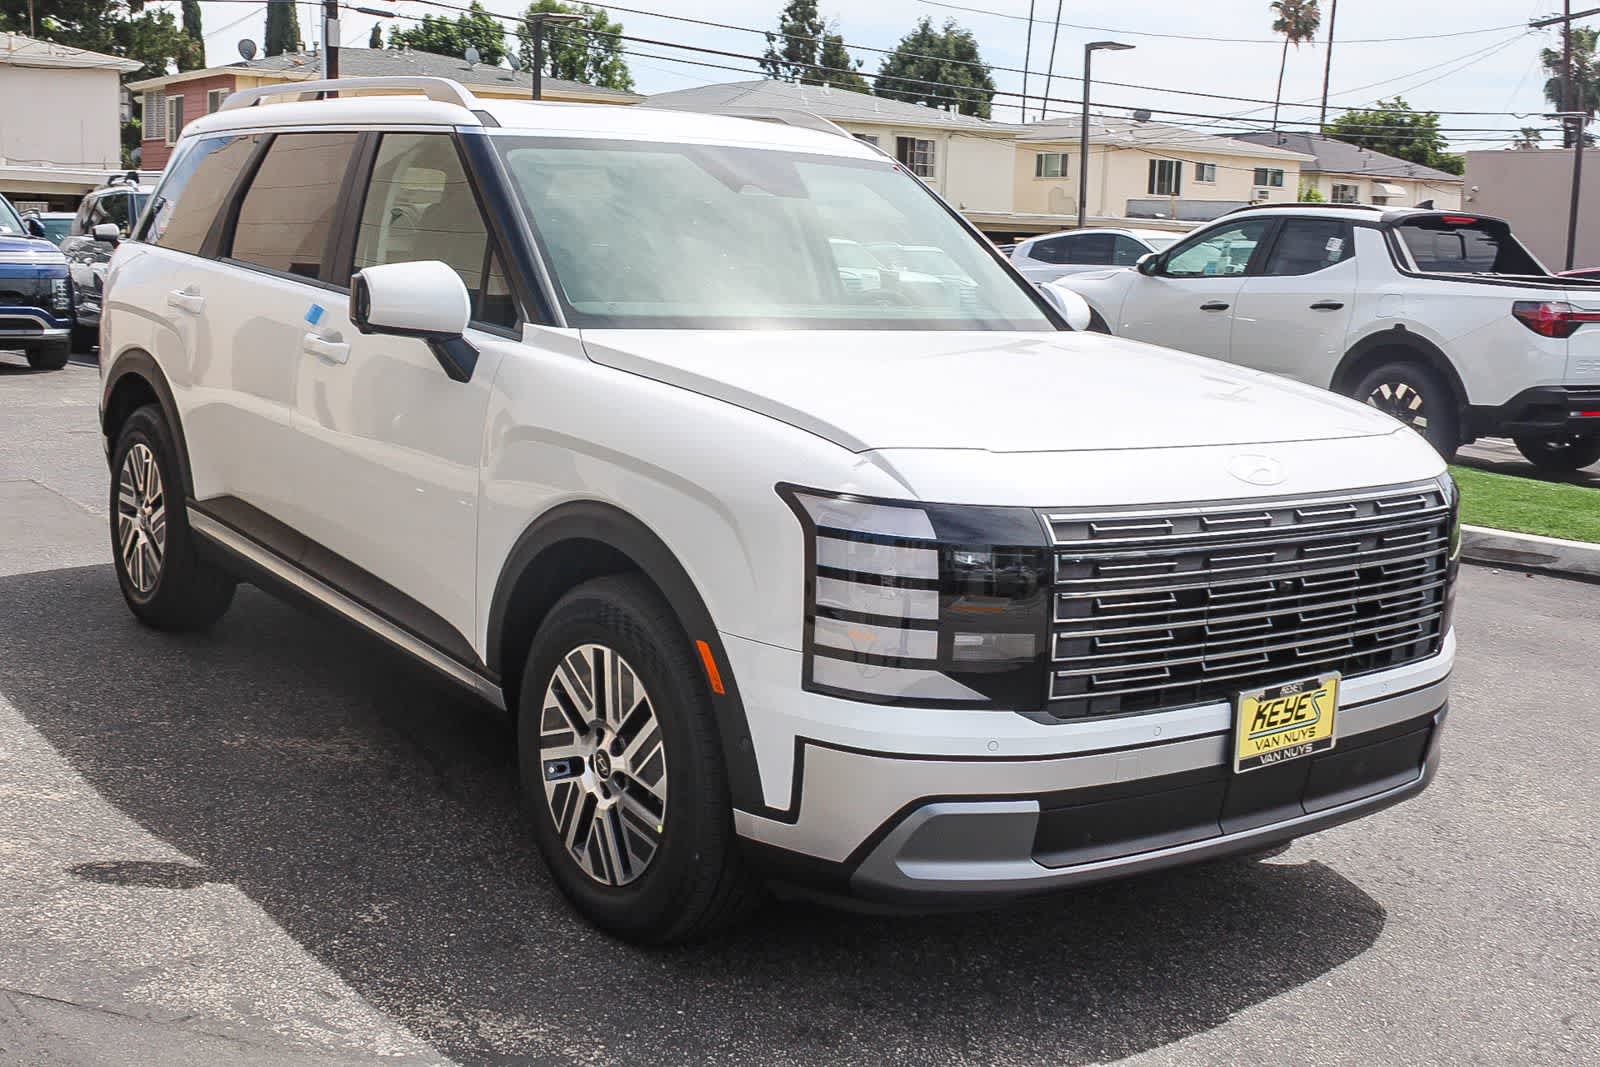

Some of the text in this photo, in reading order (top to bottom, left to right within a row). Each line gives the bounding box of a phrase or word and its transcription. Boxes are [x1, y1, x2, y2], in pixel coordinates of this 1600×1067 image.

[1250, 689, 1327, 731] KEYES
[1256, 727, 1316, 751] VAN NUYS
[1260, 743, 1313, 764] VAN NUYS
